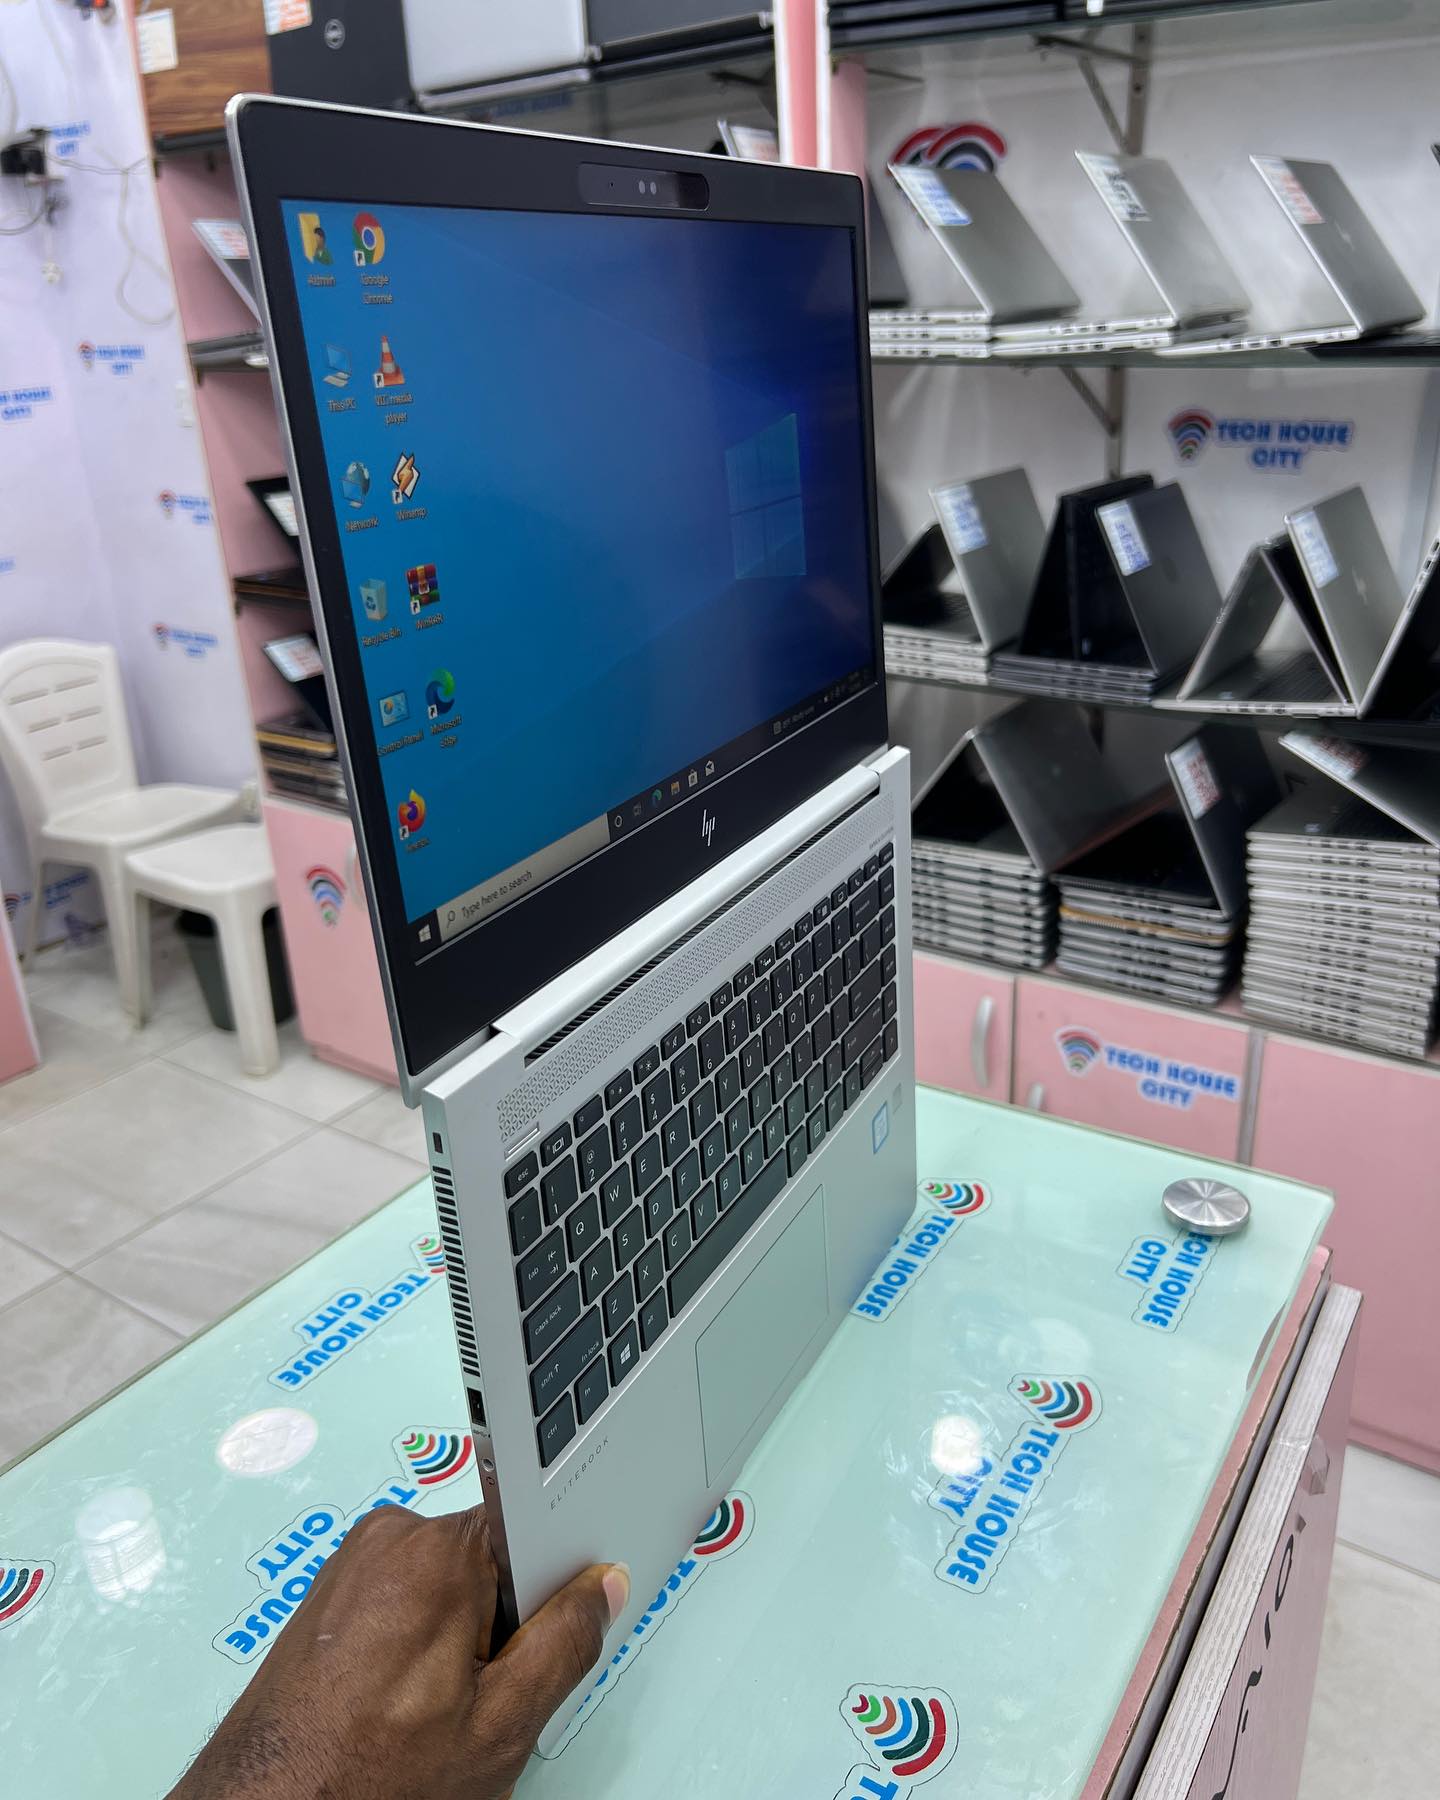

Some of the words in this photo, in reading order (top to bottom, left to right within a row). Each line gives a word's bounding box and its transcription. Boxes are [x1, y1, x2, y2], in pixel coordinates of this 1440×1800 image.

[1217, 421, 1270, 442] TECH
[1278, 422, 1349, 445] HOUSE
[1252, 448, 1302, 468] CITY
[462, 901, 481, 919] Type
[481, 889, 499, 906] here
[499, 885, 508, 896] to
[508, 869, 532, 891] search
[1105, 1047, 1160, 1075] TECH
[1167, 1063, 1235, 1095] HOUSE
[1141, 1079, 1191, 1105] CITY
[621, 1138, 628, 1151] 3
[669, 1131, 676, 1144] R
[707, 1144, 714, 1157] G
[641, 1158, 647, 1173] E
[517, 1167, 529, 1182] esc
[589, 1169, 595, 1182] 2
[681, 1172, 686, 1186] F
[722, 1178, 728, 1191] B
[609, 1185, 620, 1202] W
[652, 1202, 659, 1216] D
[698, 1204, 704, 1217] V
[576, 1221, 584, 1236] Q
[904, 1215, 955, 1258] TECH
[622, 1233, 629, 1247] S
[671, 1234, 678, 1247] C
[1175, 1232, 1213, 1267] ECH
[1126, 1240, 1167, 1283] CITY
[590, 1267, 598, 1280] A
[642, 1266, 649, 1280] X
[856, 1258, 919, 1317] HOUSE
[360, 1274, 430, 1321] TECH
[1142, 1267, 1193, 1327] HOUSE
[611, 1299, 618, 1314] Z
[302, 1292, 363, 1339] CITY
[534, 1319, 549, 1336] caps
[277, 1321, 367, 1385] HOUSE
[547, 1424, 558, 1439] ctrl
[1000, 1428, 1060, 1494] TECH
[550, 1436, 610, 1511] ELITEBOOK
[257, 1511, 334, 1581] CITY
[946, 1494, 1020, 1585] HOUSE
